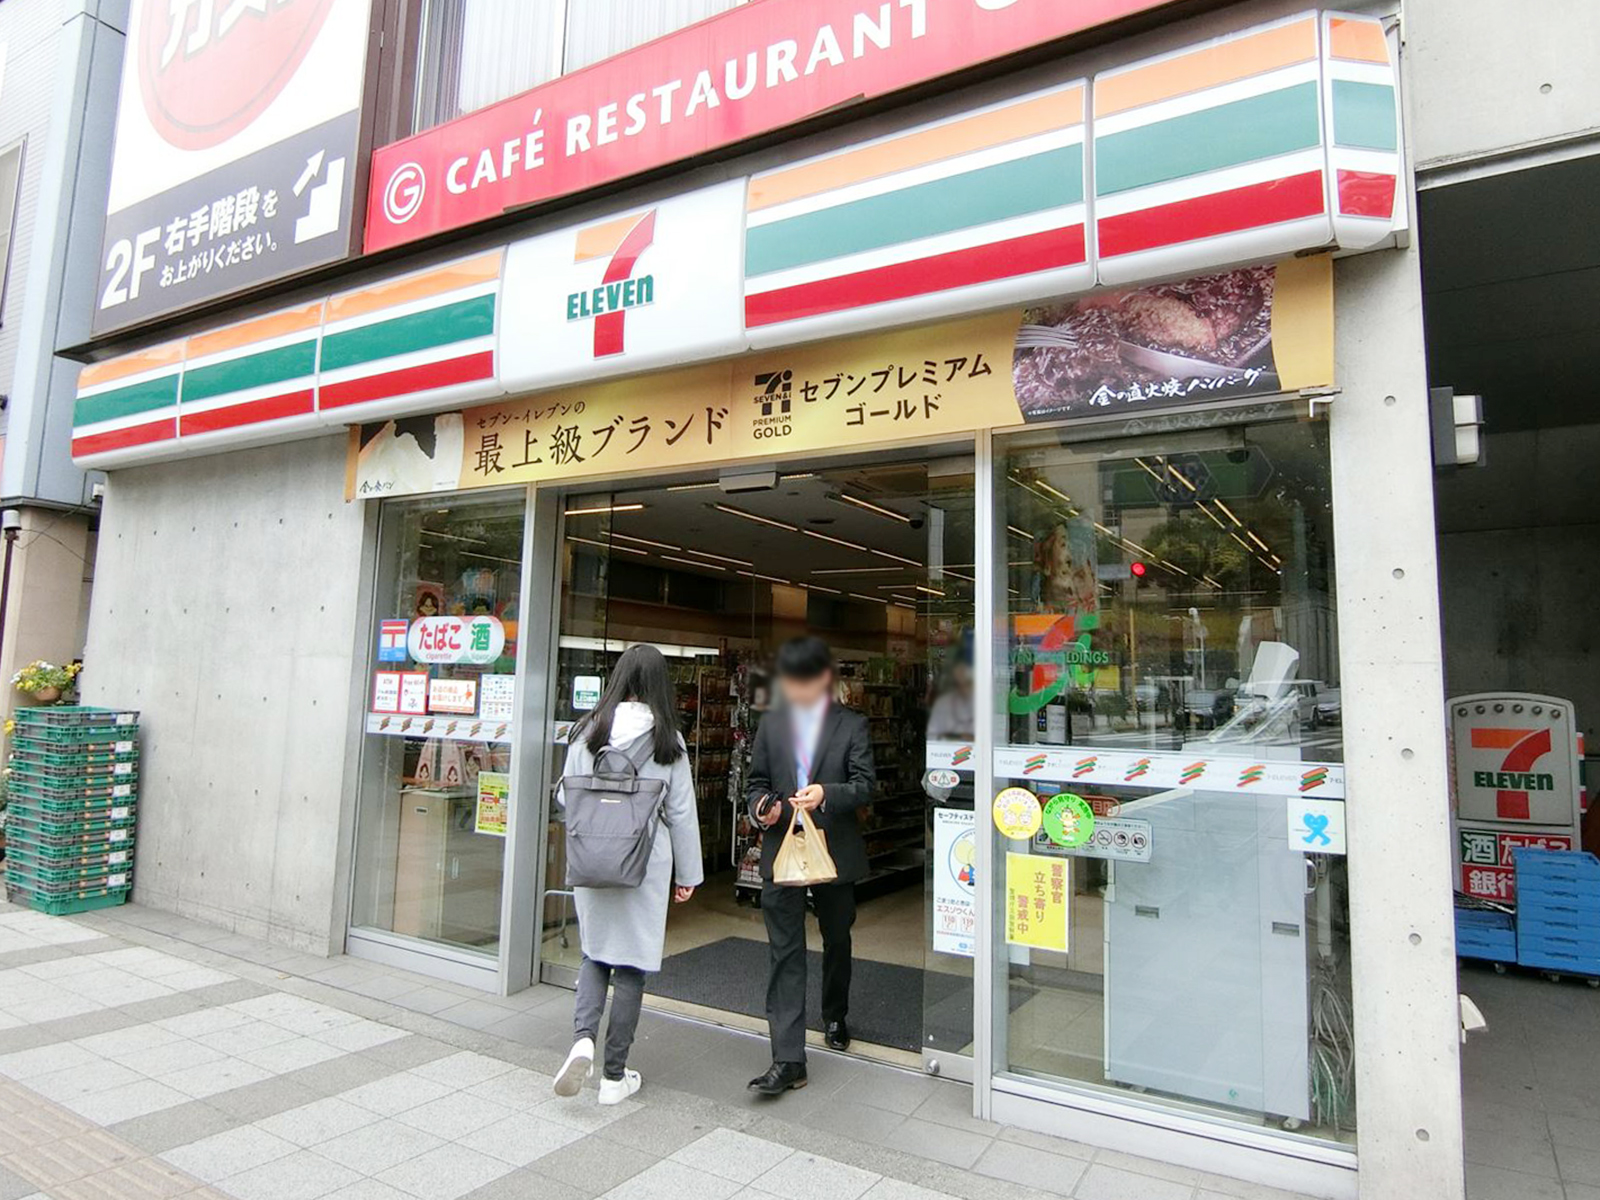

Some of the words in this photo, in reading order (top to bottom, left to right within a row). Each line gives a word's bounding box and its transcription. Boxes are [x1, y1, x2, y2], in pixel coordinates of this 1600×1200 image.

[446, 108, 547, 195] CAFÉ
[566, 0, 926, 157] RESTAURANT
[164, 187, 278, 256] 右手階段を
[101, 227, 161, 310] 2F
[159, 231, 278, 288] お上がりください。
[800, 353, 992, 403] セブンプレミアム
[752, 415, 792, 427] PREMIUM
[846, 393, 941, 427] ゴールド
[474, 406, 730, 476] 最上級ブランド
[753, 424, 792, 440] GOLD
[418, 622, 462, 651] たばこ
[470, 622, 491, 651] 酒
[1060, 651, 1110, 664] LDINGS
[1463, 833, 1496, 863] 酒
[1034, 871, 1046, 923] 立ち寄り
[1051, 863, 1063, 904] 警察官
[1017, 894, 1029, 935] 警戒中
